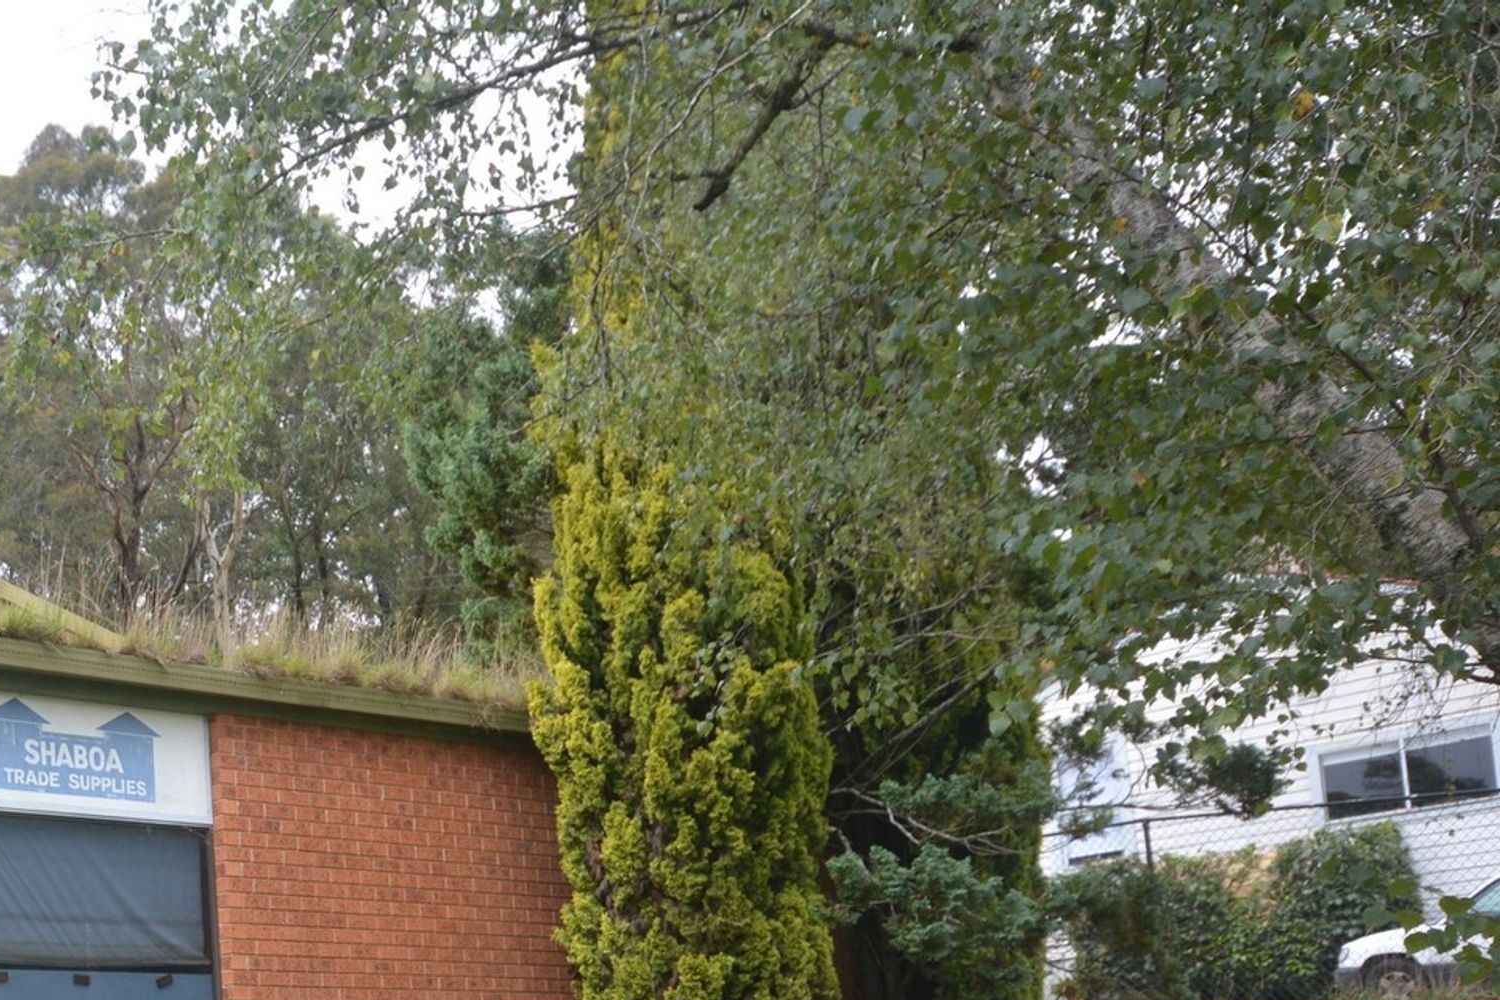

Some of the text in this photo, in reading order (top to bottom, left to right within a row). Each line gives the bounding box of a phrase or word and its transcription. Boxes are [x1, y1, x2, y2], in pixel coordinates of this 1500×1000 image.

[24, 739, 124, 773] SHABOA
[4, 767, 147, 797] TRADE SUPPLIES
